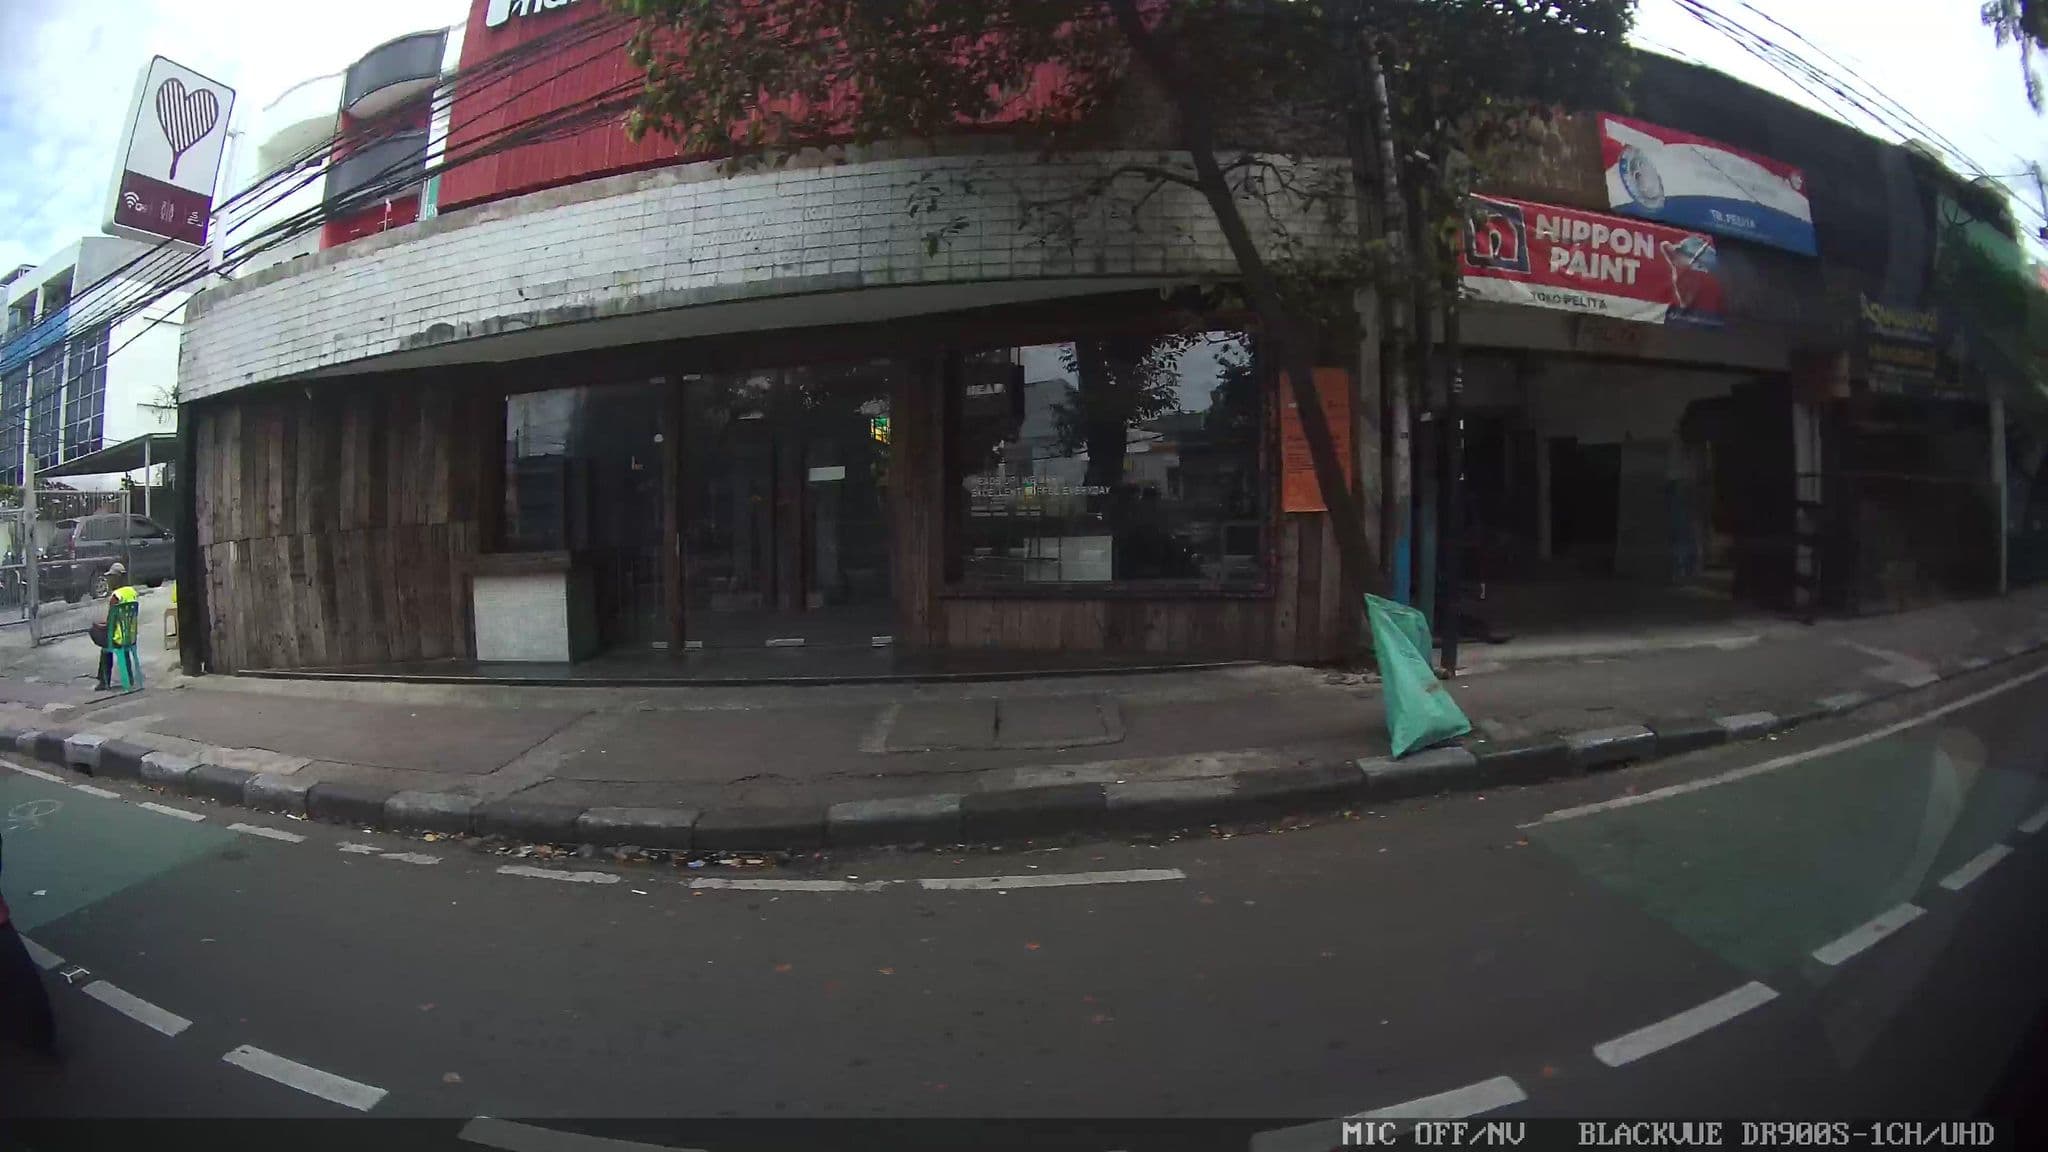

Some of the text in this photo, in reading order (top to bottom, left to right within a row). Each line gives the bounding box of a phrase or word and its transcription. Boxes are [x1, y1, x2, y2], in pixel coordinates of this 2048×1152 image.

[1535, 213, 1655, 261] NIPPON
[1549, 246, 1641, 285] PAINT
[1562, 294, 1608, 309] PELITA
[1063, 485, 1111, 497] EVERYDAY
